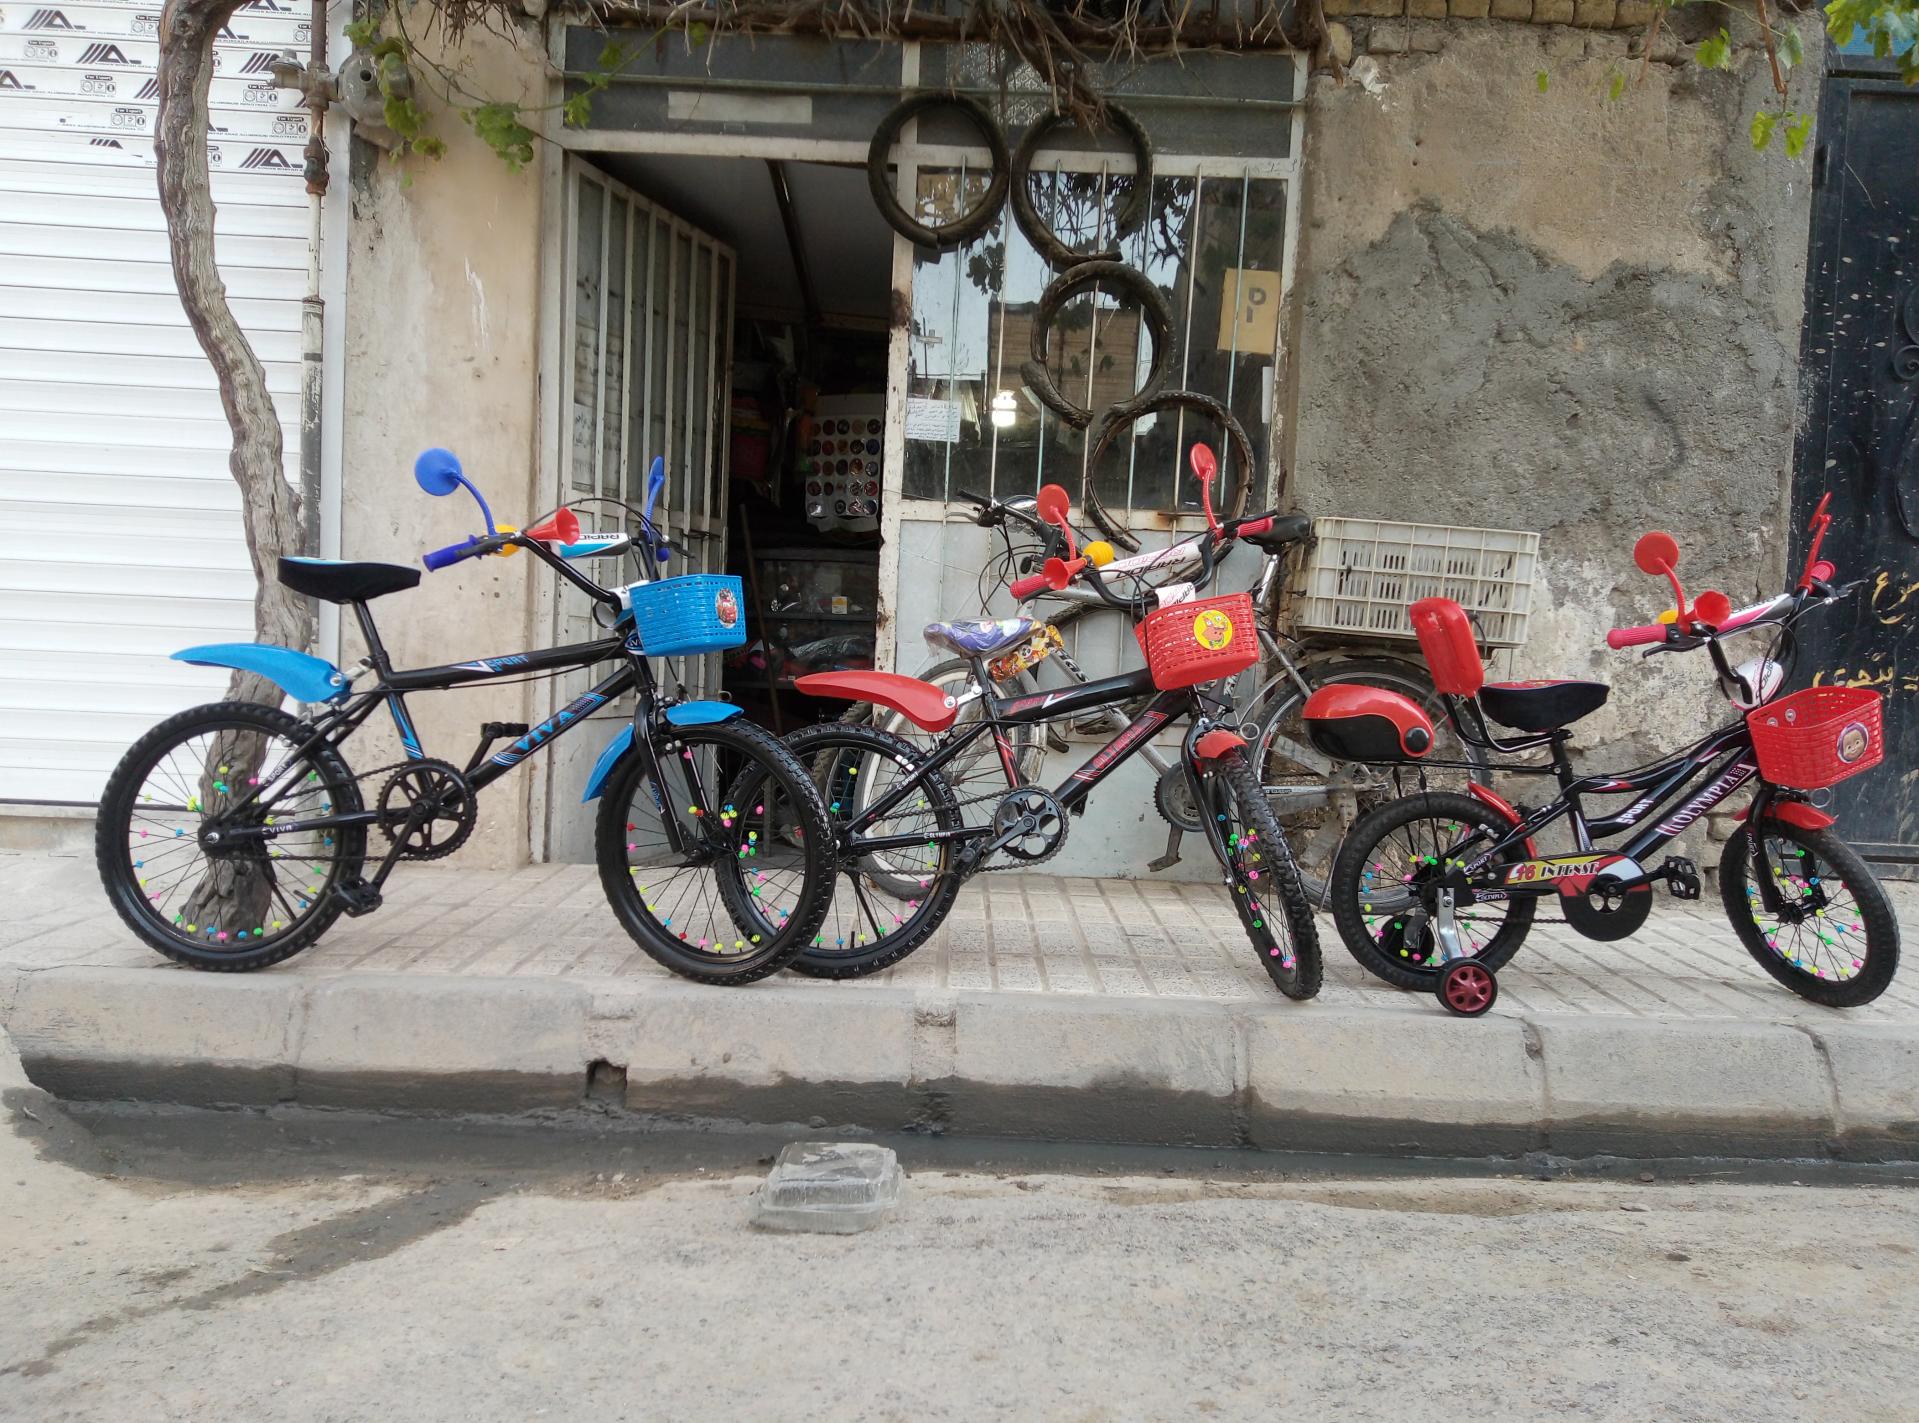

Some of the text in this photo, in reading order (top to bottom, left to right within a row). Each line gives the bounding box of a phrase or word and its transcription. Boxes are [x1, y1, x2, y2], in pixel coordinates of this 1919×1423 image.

[489, 655, 529, 672] SPORT
[513, 711, 575, 750] VIVA
[901, 770, 919, 786] SPORT
[1671, 773, 1739, 828] OLYMPIA
[1615, 798, 1654, 824] SPORT
[269, 824, 292, 834] VIVA
[1469, 855, 1488, 870] SPORT
[1540, 861, 1599, 877] INTENSE
